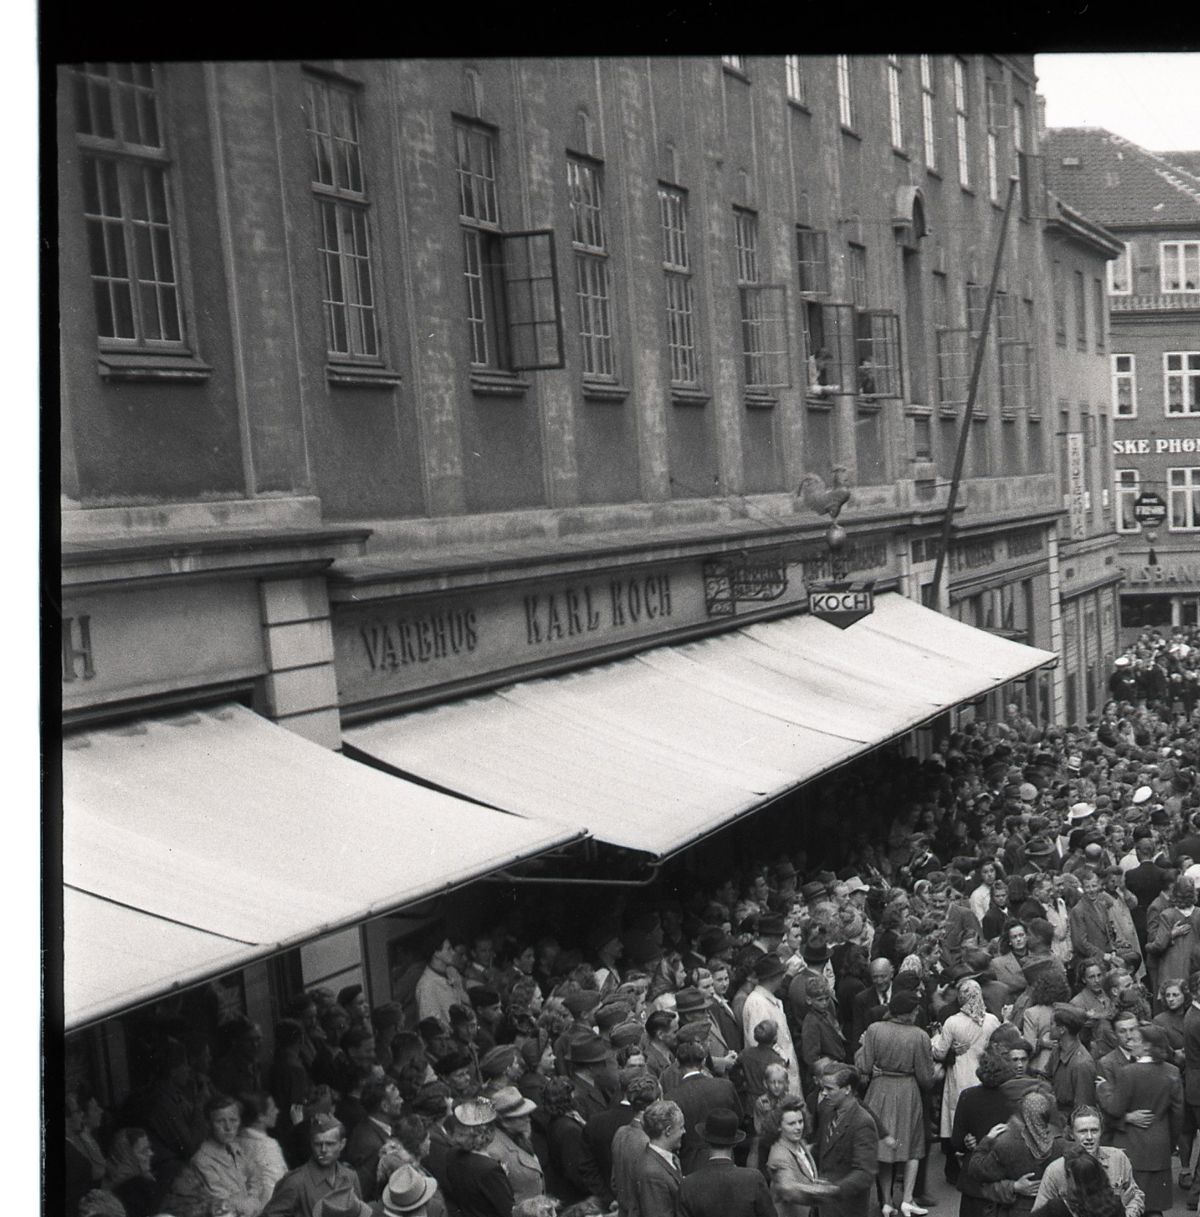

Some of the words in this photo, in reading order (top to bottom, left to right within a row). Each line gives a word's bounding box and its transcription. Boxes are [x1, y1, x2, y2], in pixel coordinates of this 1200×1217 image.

[360, 608, 478, 671] VAREHUS
[523, 584, 600, 645] KARL
[609, 573, 673, 626] KOCH
[812, 595, 868, 611] KOCH
